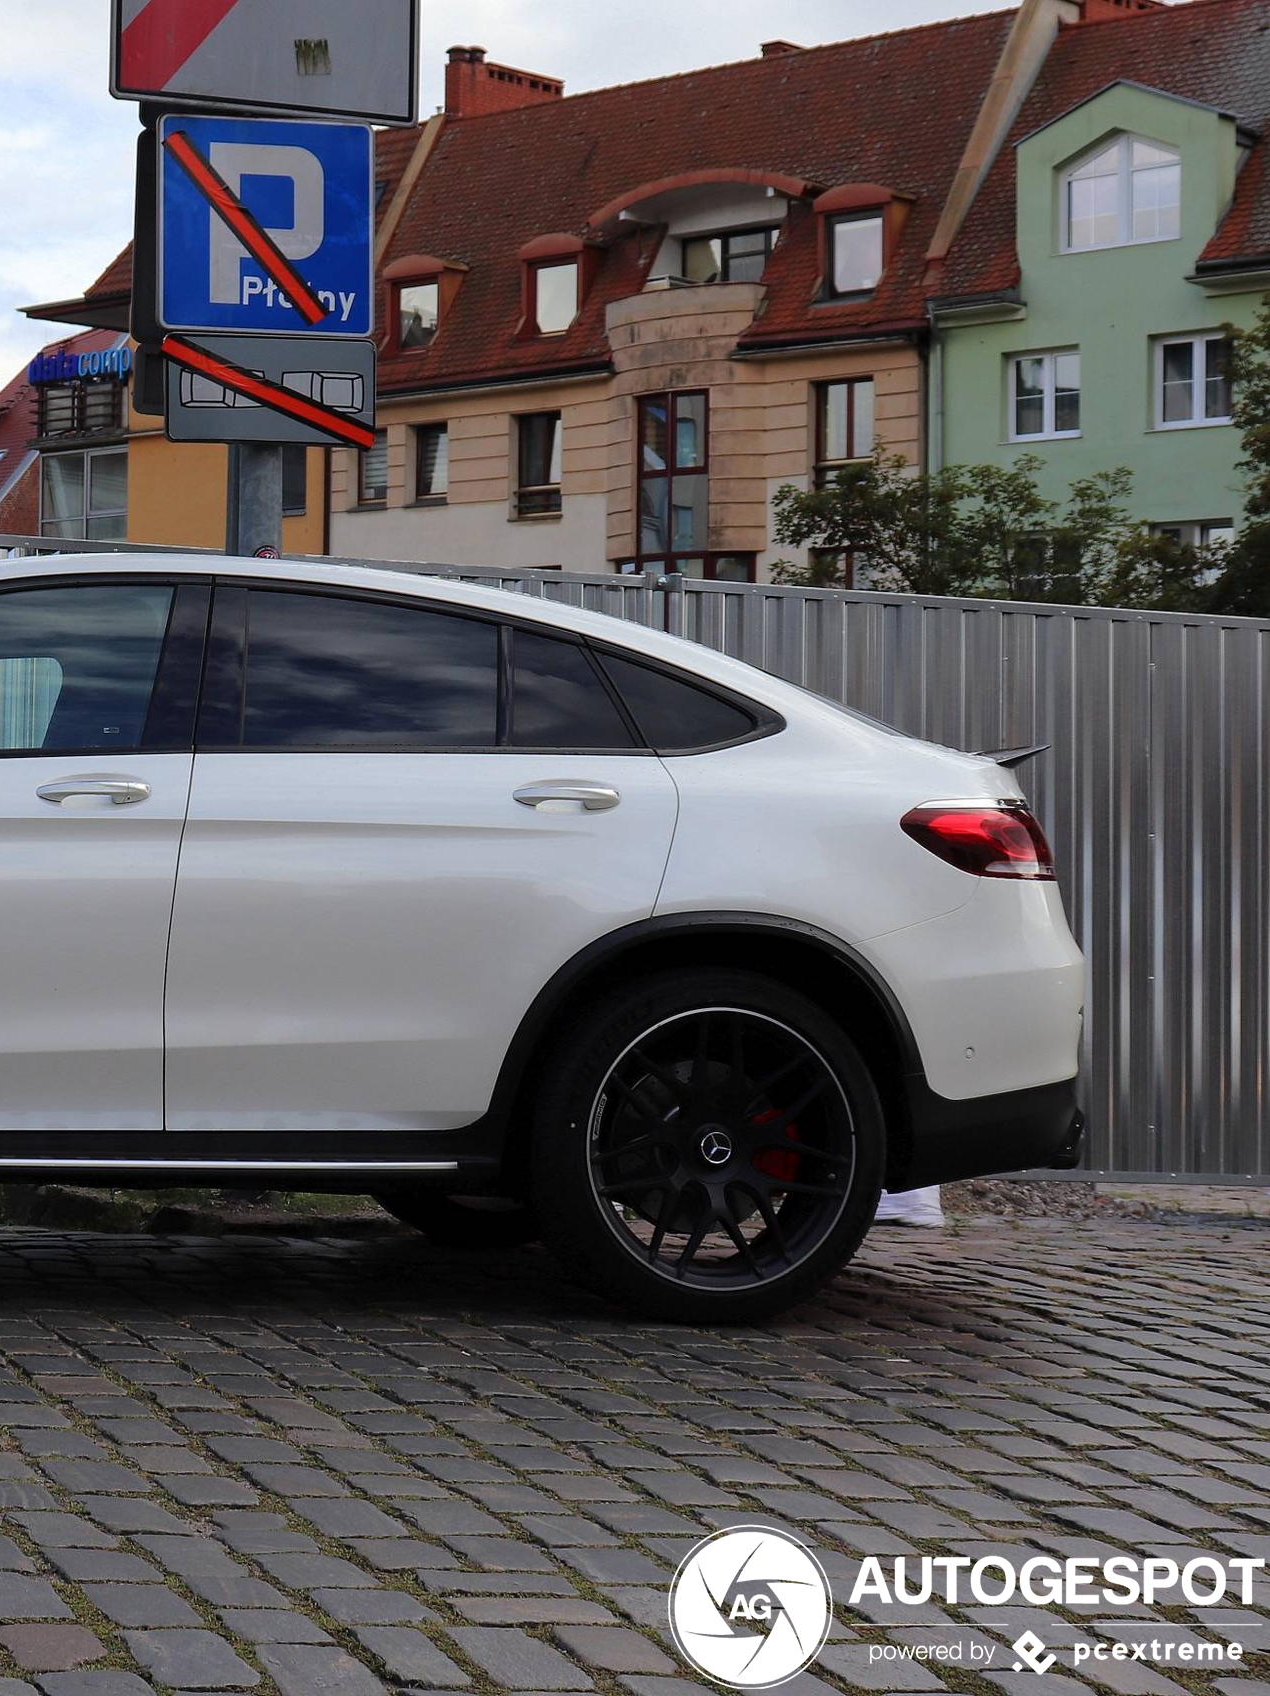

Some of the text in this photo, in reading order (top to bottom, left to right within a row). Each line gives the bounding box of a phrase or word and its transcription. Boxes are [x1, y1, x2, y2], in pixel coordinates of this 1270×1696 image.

[209, 142, 324, 305] P
[242, 275, 356, 322] Płny
[28, 347, 132, 382] datacomp
